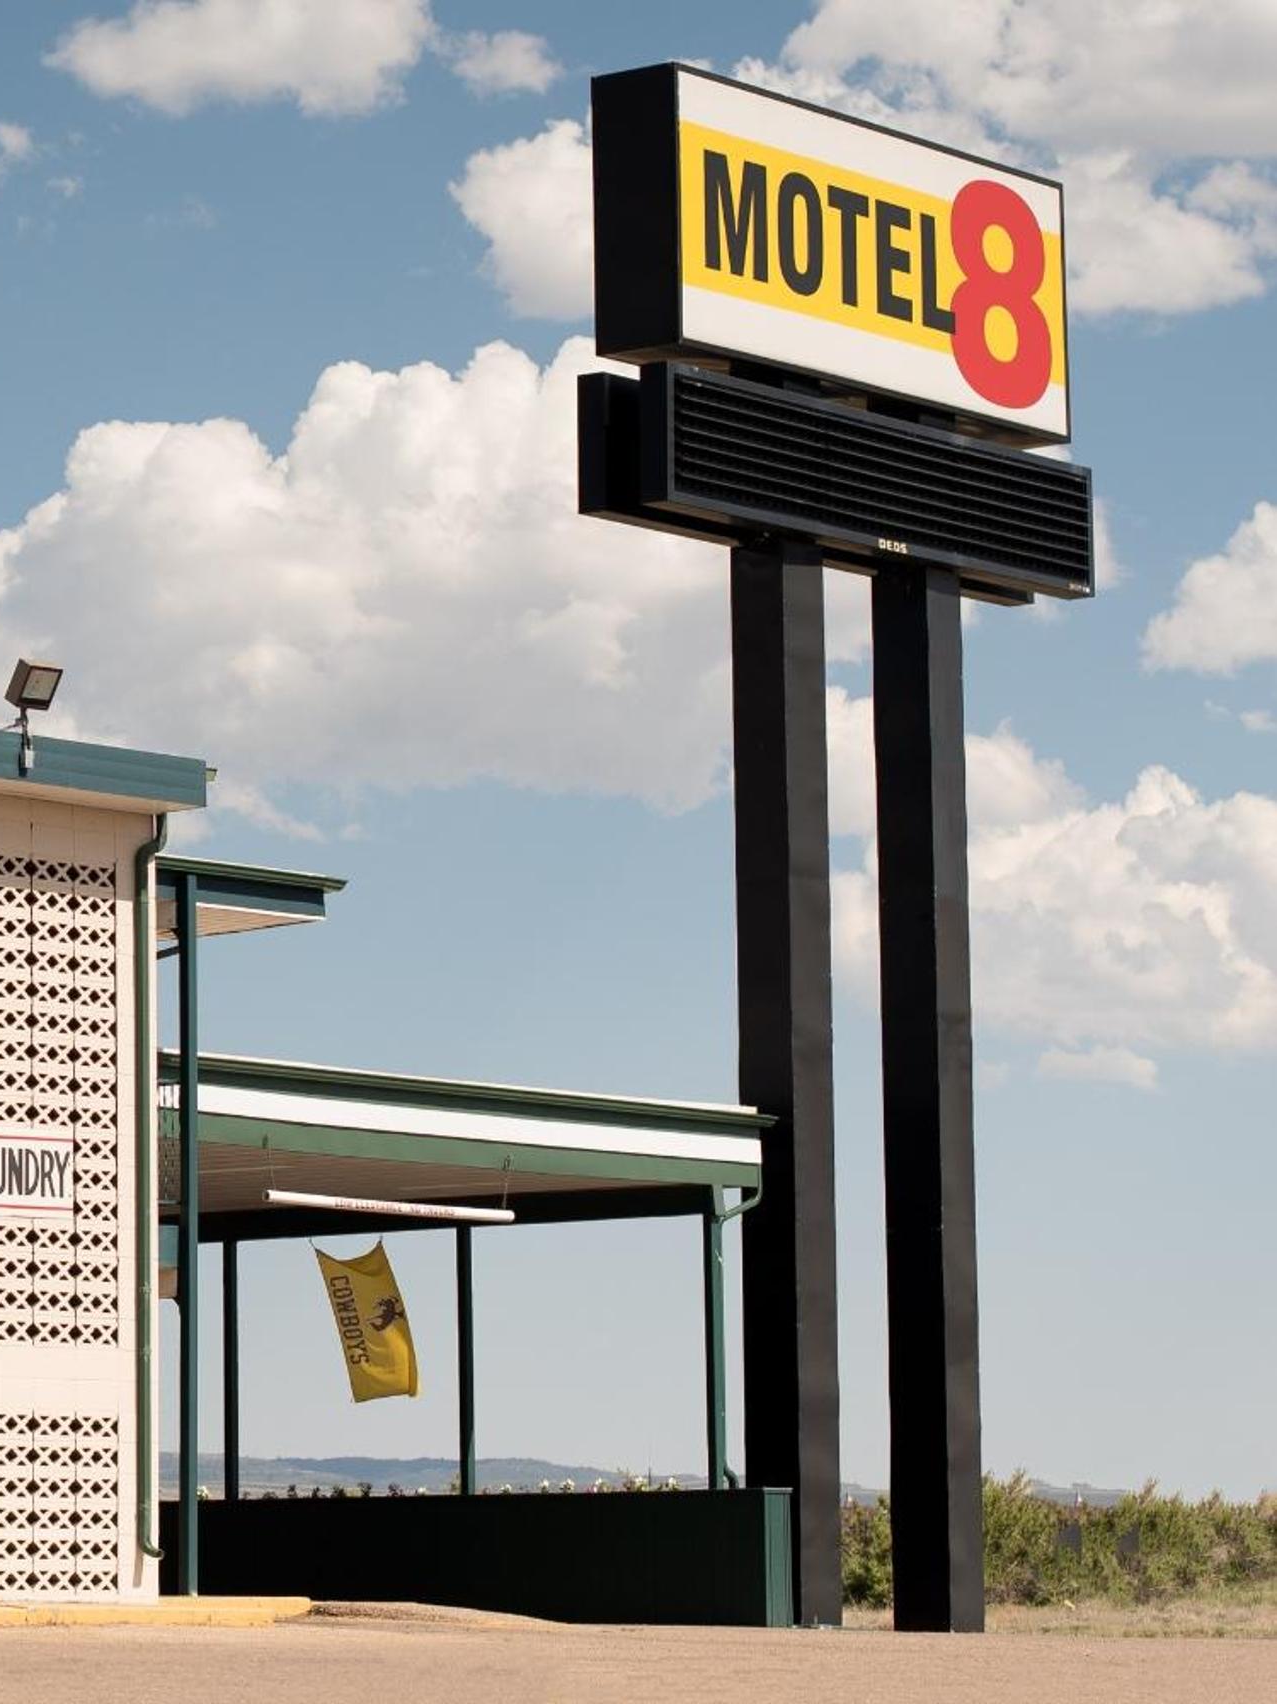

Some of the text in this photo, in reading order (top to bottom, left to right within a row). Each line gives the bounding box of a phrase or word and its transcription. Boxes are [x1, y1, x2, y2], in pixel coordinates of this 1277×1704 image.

[704, 149, 1053, 409] MOTEL 8
[329, 1275, 371, 1366] COWBOYS
